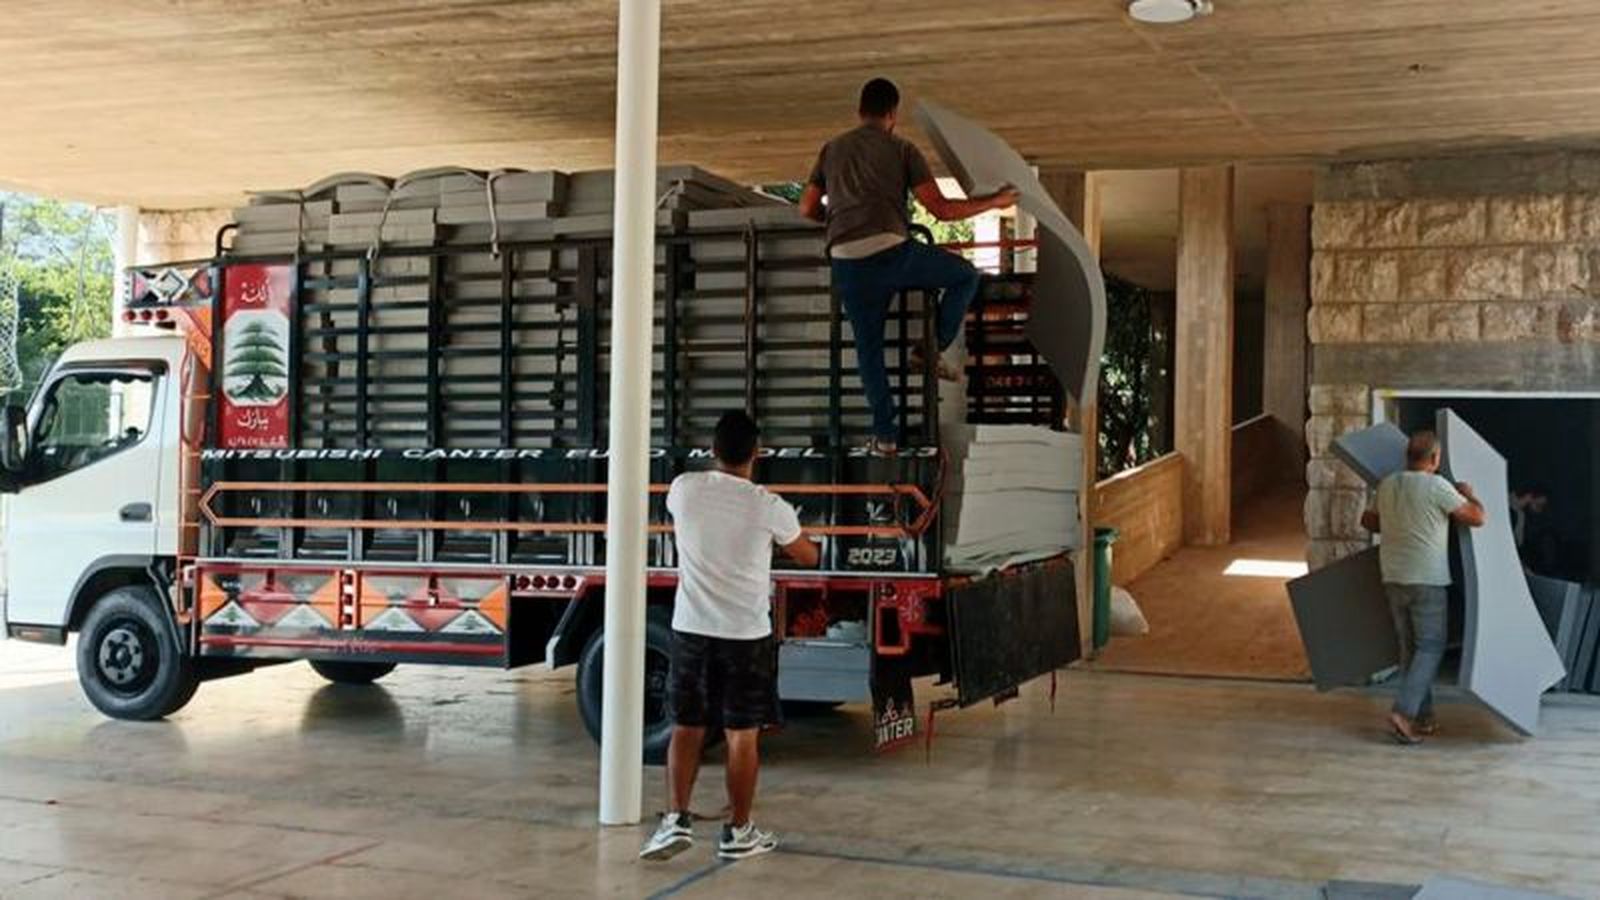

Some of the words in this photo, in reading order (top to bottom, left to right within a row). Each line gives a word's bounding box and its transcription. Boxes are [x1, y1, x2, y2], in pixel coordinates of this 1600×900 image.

[201, 448, 383, 460] MITSUBISHI
[402, 448, 543, 461] CANTER
[565, 448, 667, 458] EUO
[688, 447, 825, 458] MDEL
[847, 547, 897, 566] 2023
